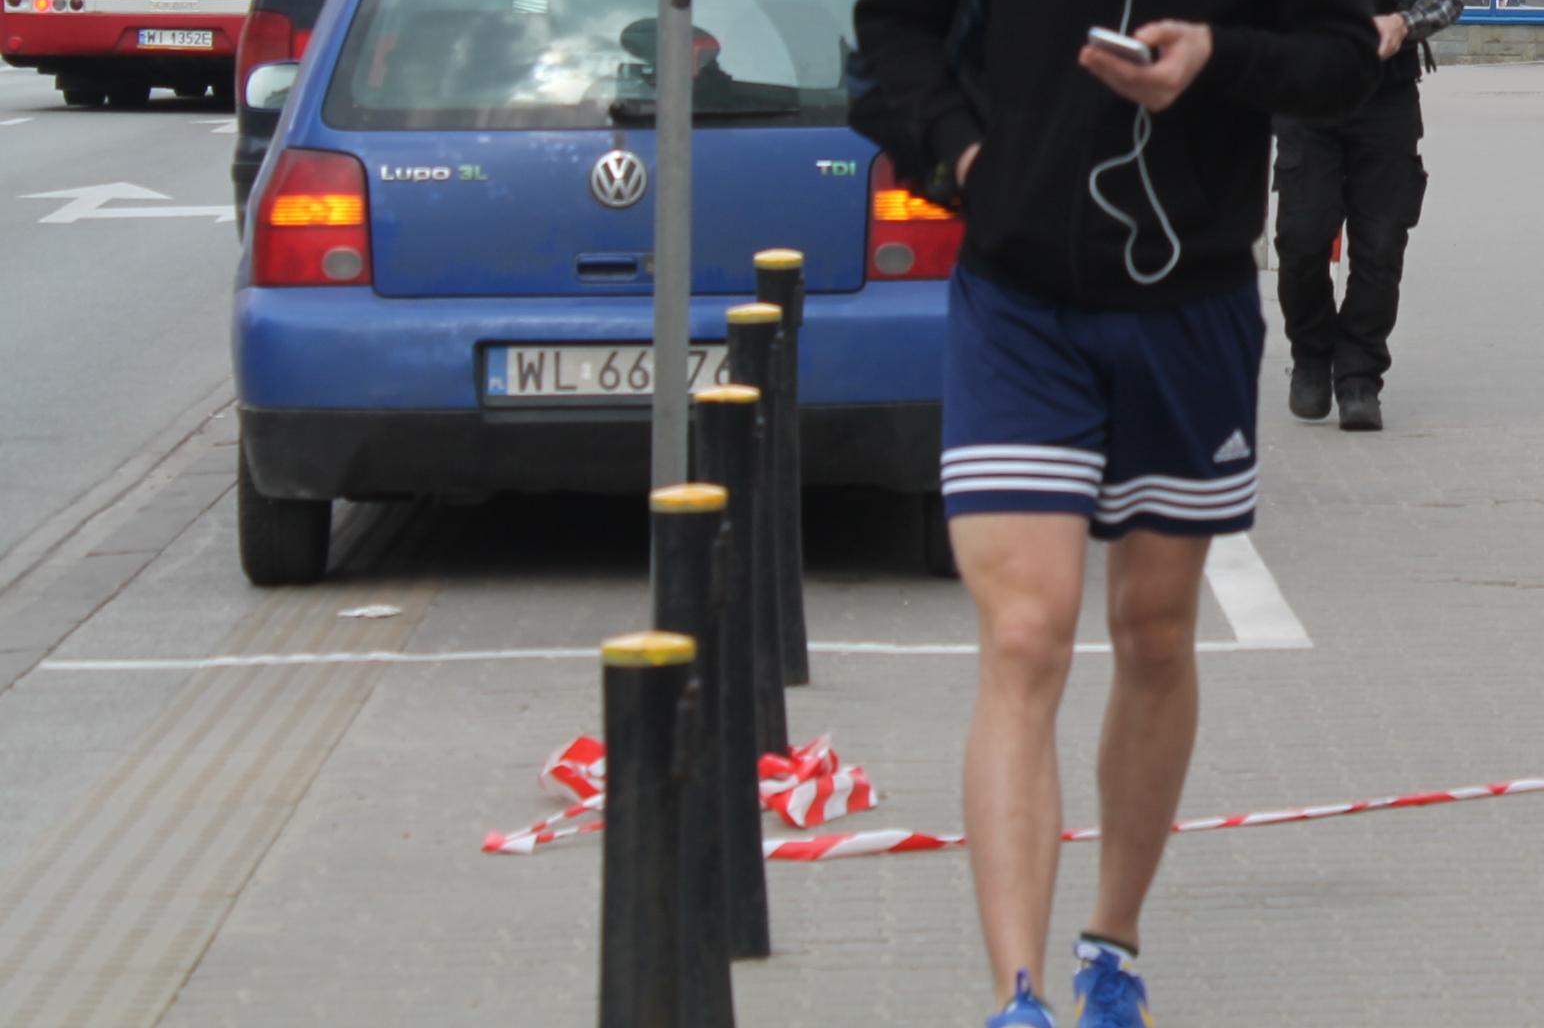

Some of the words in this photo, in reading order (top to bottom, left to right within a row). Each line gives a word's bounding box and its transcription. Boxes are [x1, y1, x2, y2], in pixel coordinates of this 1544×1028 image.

[458, 164, 488, 180] 3L
[816, 160, 856, 176] TDI
[516, 351, 578, 392] WL
[598, 350, 730, 392] 6676
